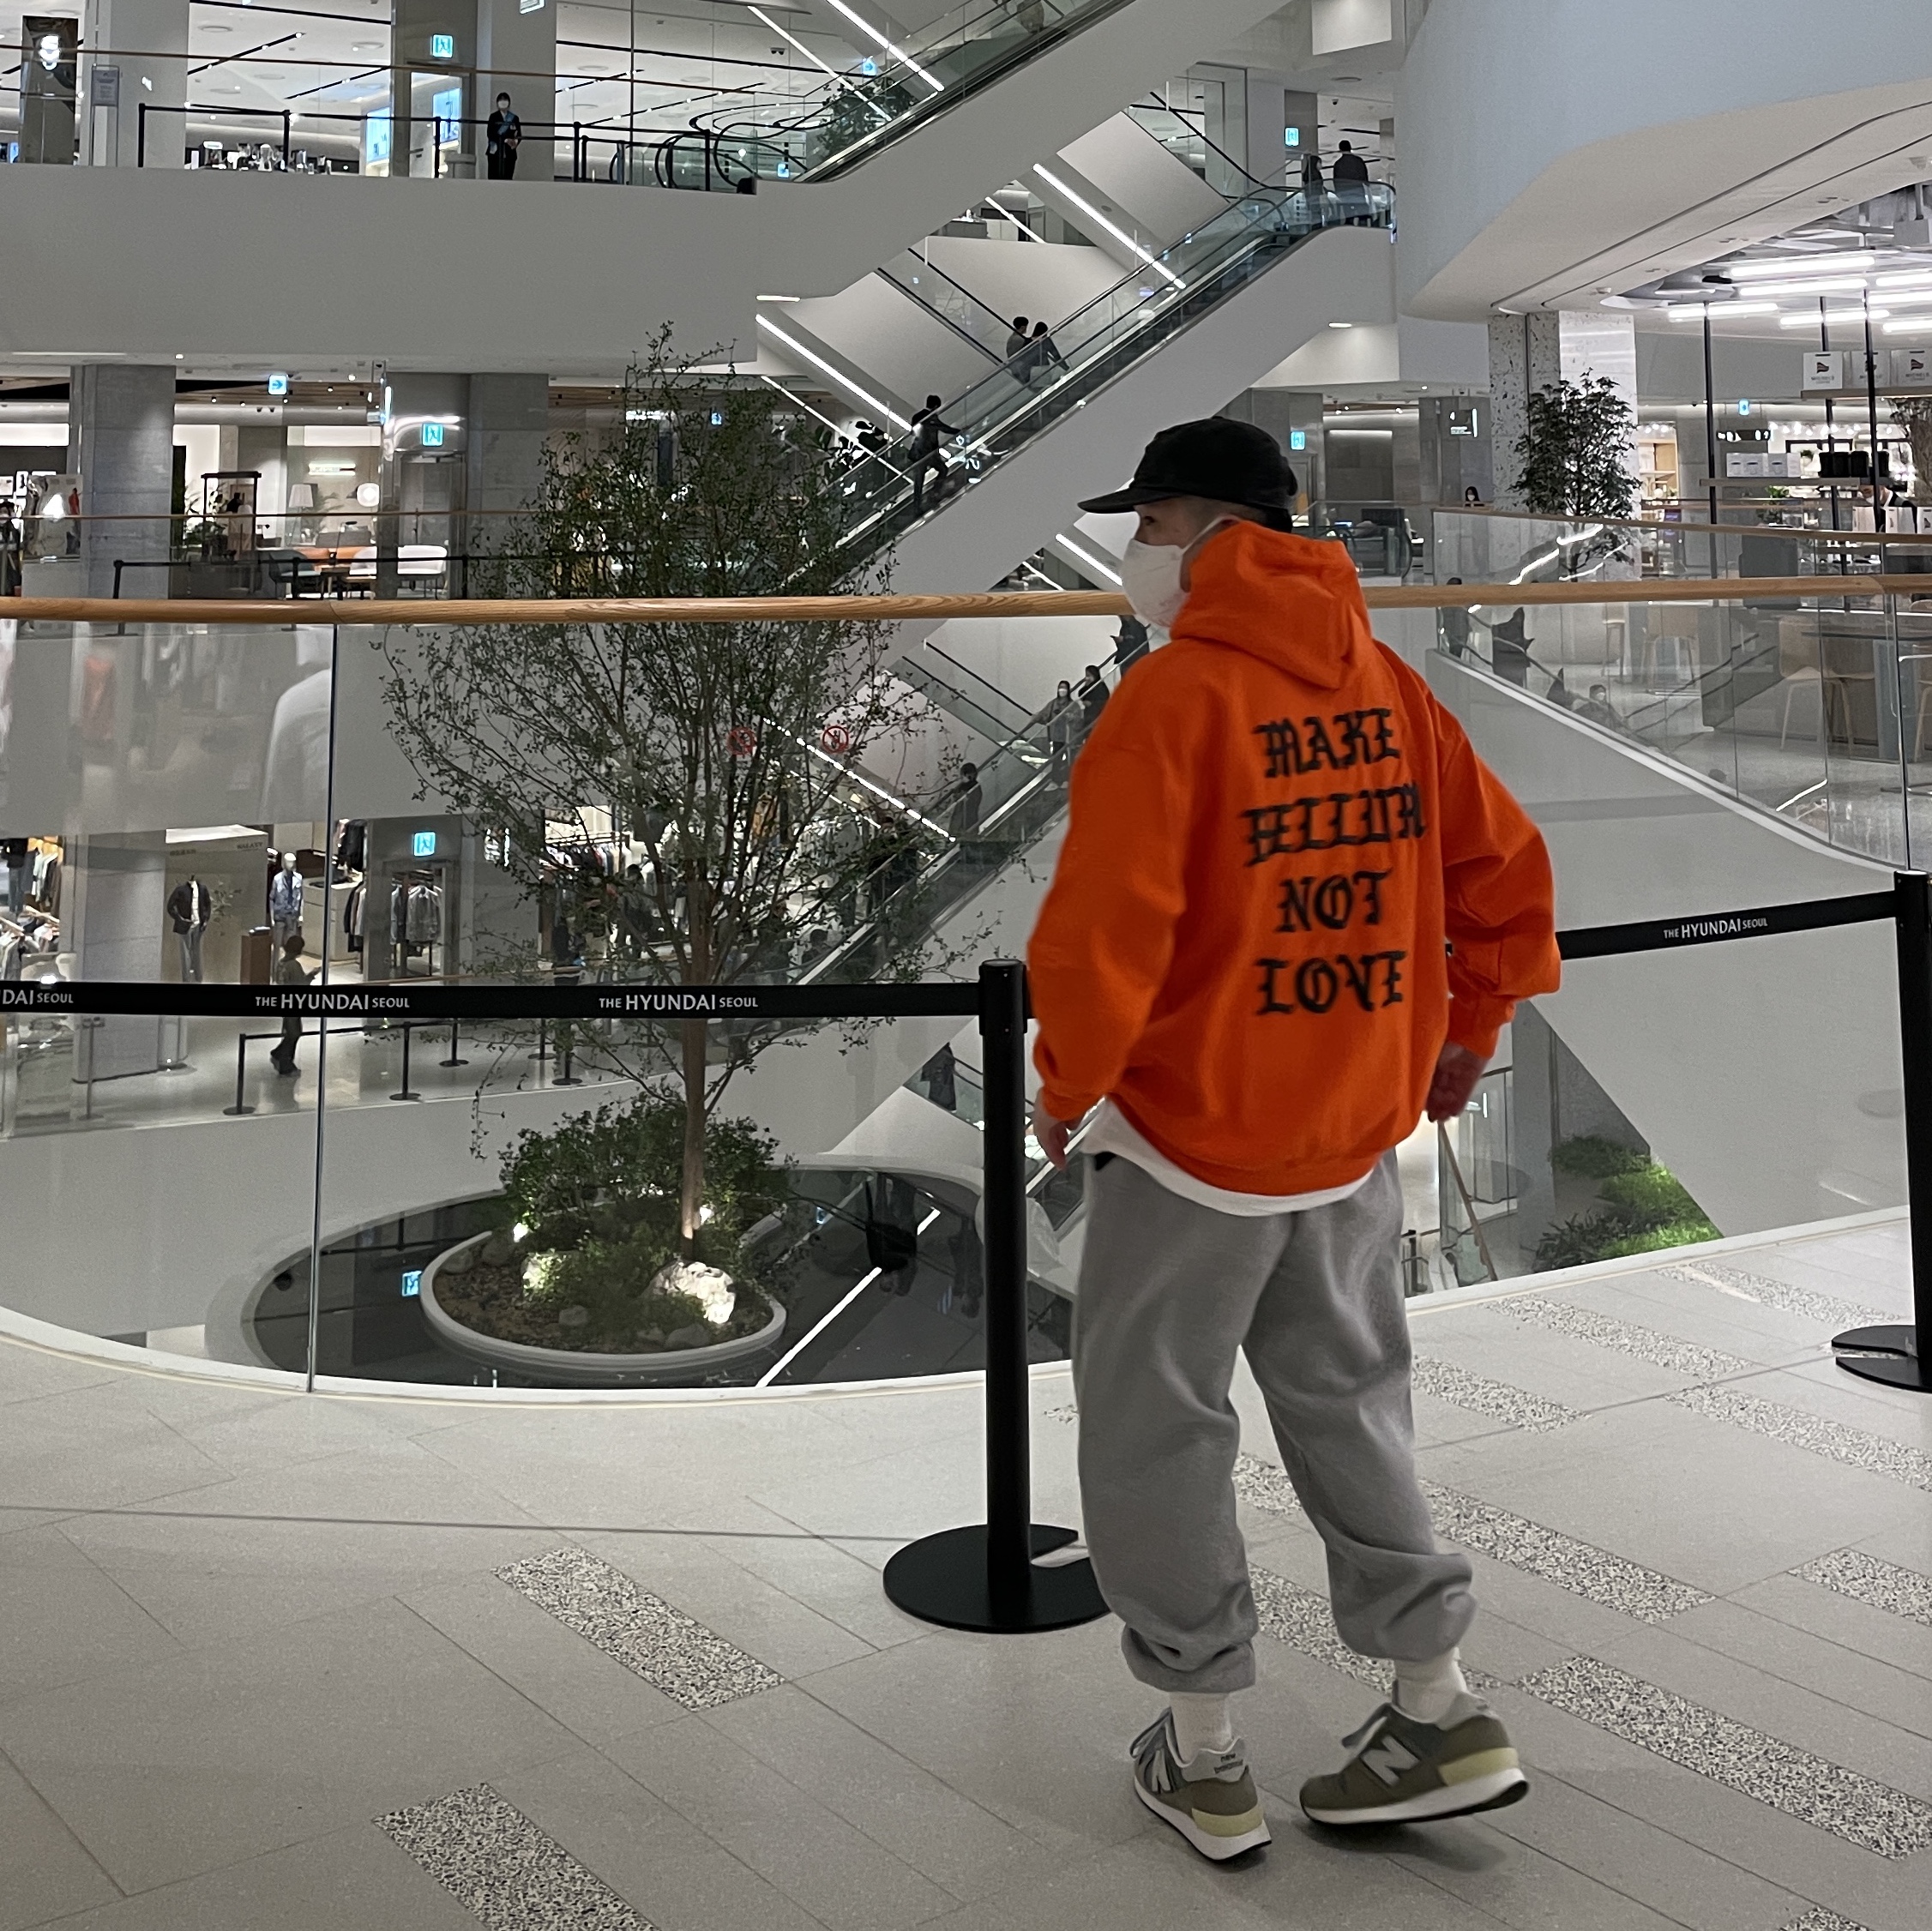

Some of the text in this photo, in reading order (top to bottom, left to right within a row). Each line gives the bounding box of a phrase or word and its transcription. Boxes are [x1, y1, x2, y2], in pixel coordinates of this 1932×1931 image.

[1252, 707, 1401, 779] MAKE
[1275, 867, 1393, 933] NOT
[1664, 917, 1768, 939] THE HYUNDAI SEOUL
[1254, 950, 1406, 1016] LOVE
[0, 989, 74, 1005] DAI SEOUL
[256, 994, 410, 1010] THE HYUNDAI SEOUL
[599, 994, 759, 1010] THE HYUNDAI SEOUL
